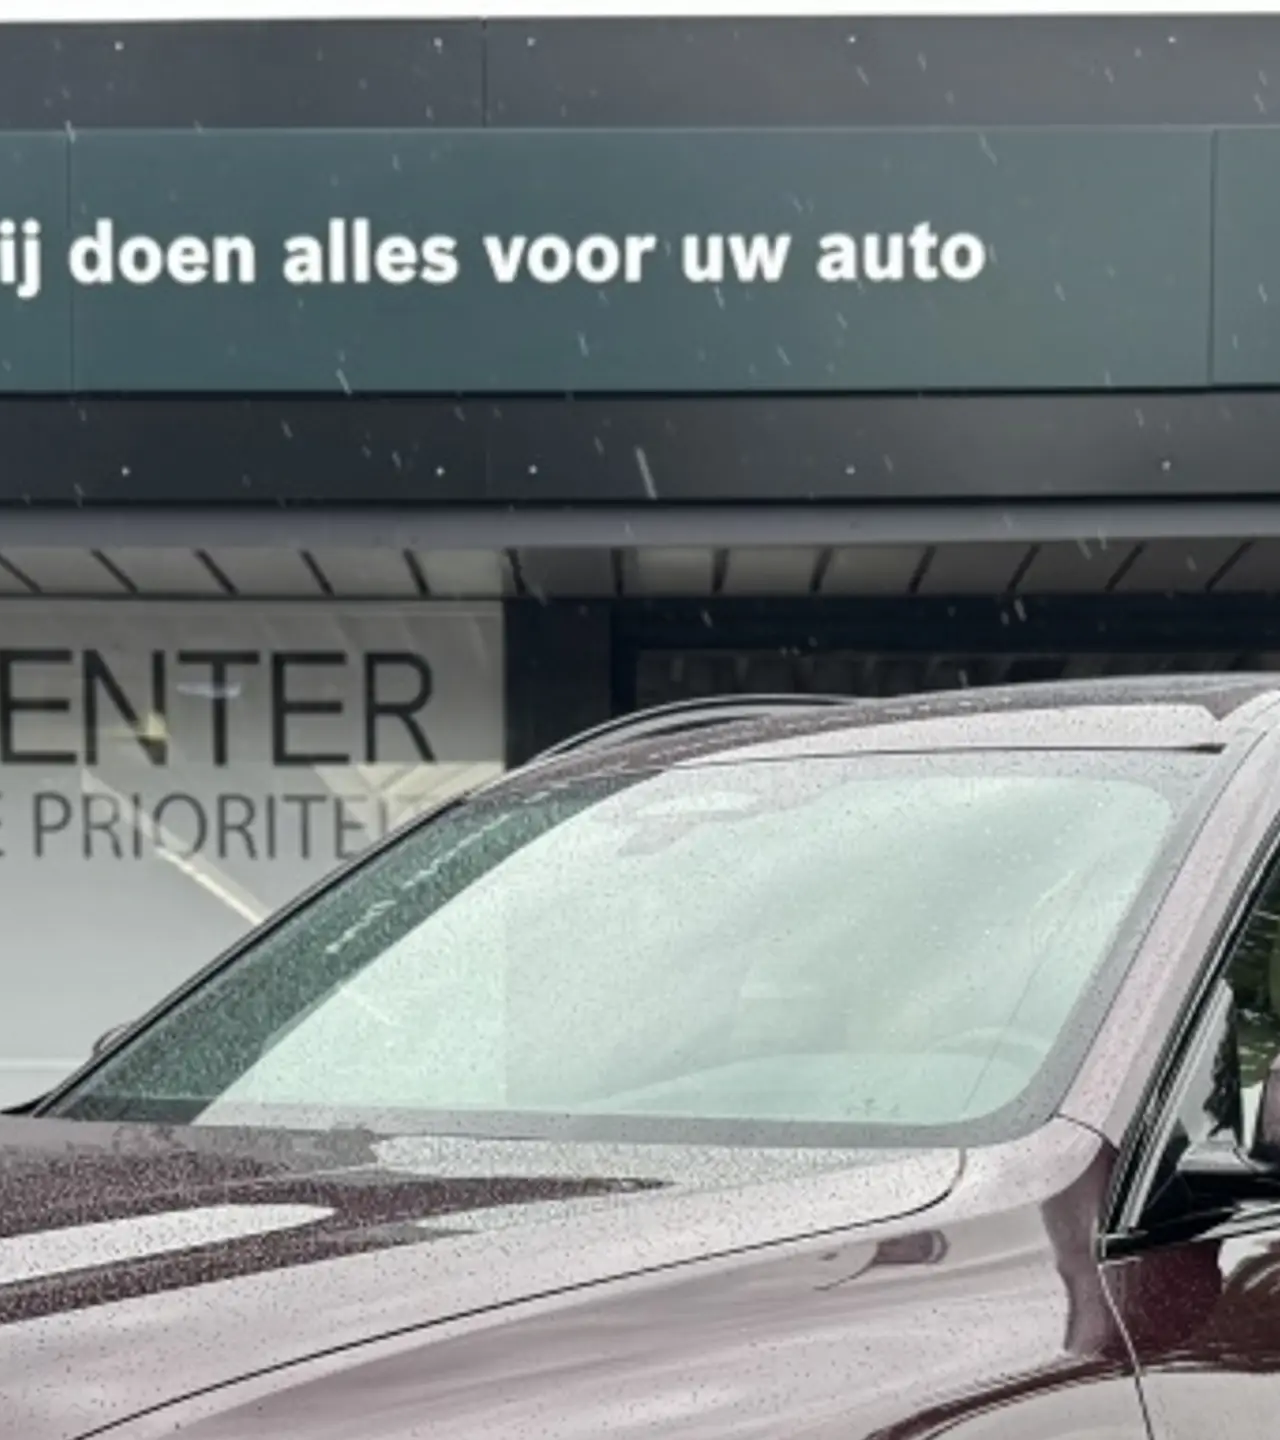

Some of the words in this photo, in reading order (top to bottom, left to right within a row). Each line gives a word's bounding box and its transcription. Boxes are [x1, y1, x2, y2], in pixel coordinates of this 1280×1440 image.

[68, 218, 256, 284] doen
[283, 218, 458, 284] alles
[483, 234, 656, 283] voor
[681, 234, 791, 283] uw
[817, 221, 985, 282] auto
[32, 790, 426, 861] PRIORITEI
